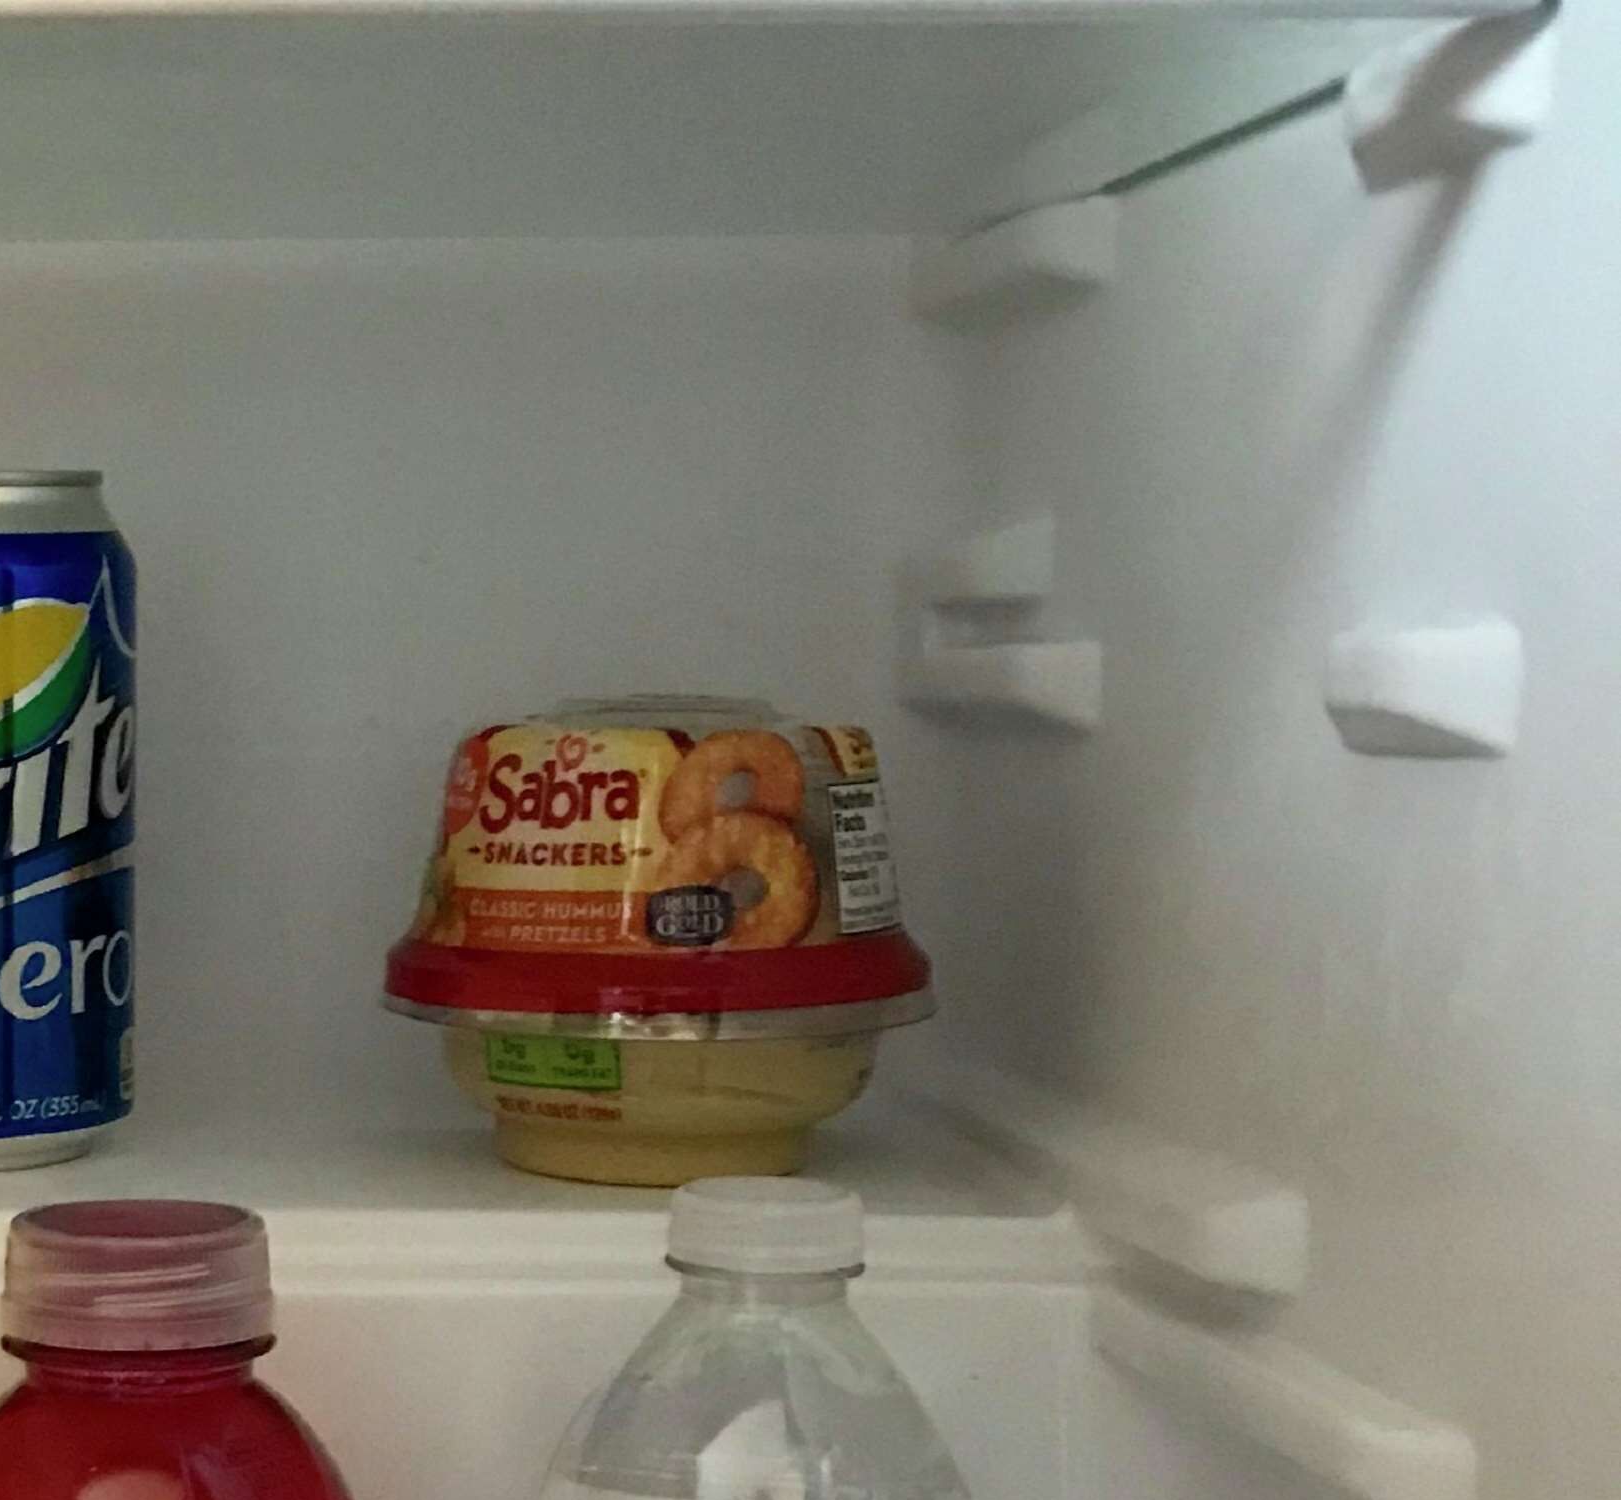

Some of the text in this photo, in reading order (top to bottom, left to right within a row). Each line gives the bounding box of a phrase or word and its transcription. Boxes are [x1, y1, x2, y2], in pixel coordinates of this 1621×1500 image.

[480, 753, 640, 834] Sabra
[483, 842, 627, 866] SNACKERS
[470, 899, 537, 919] CLASSIC
[509, 925, 608, 943] PRETZELS
[656, 913, 724, 937] GOLD
[10, 1098, 39, 1120] OZ
